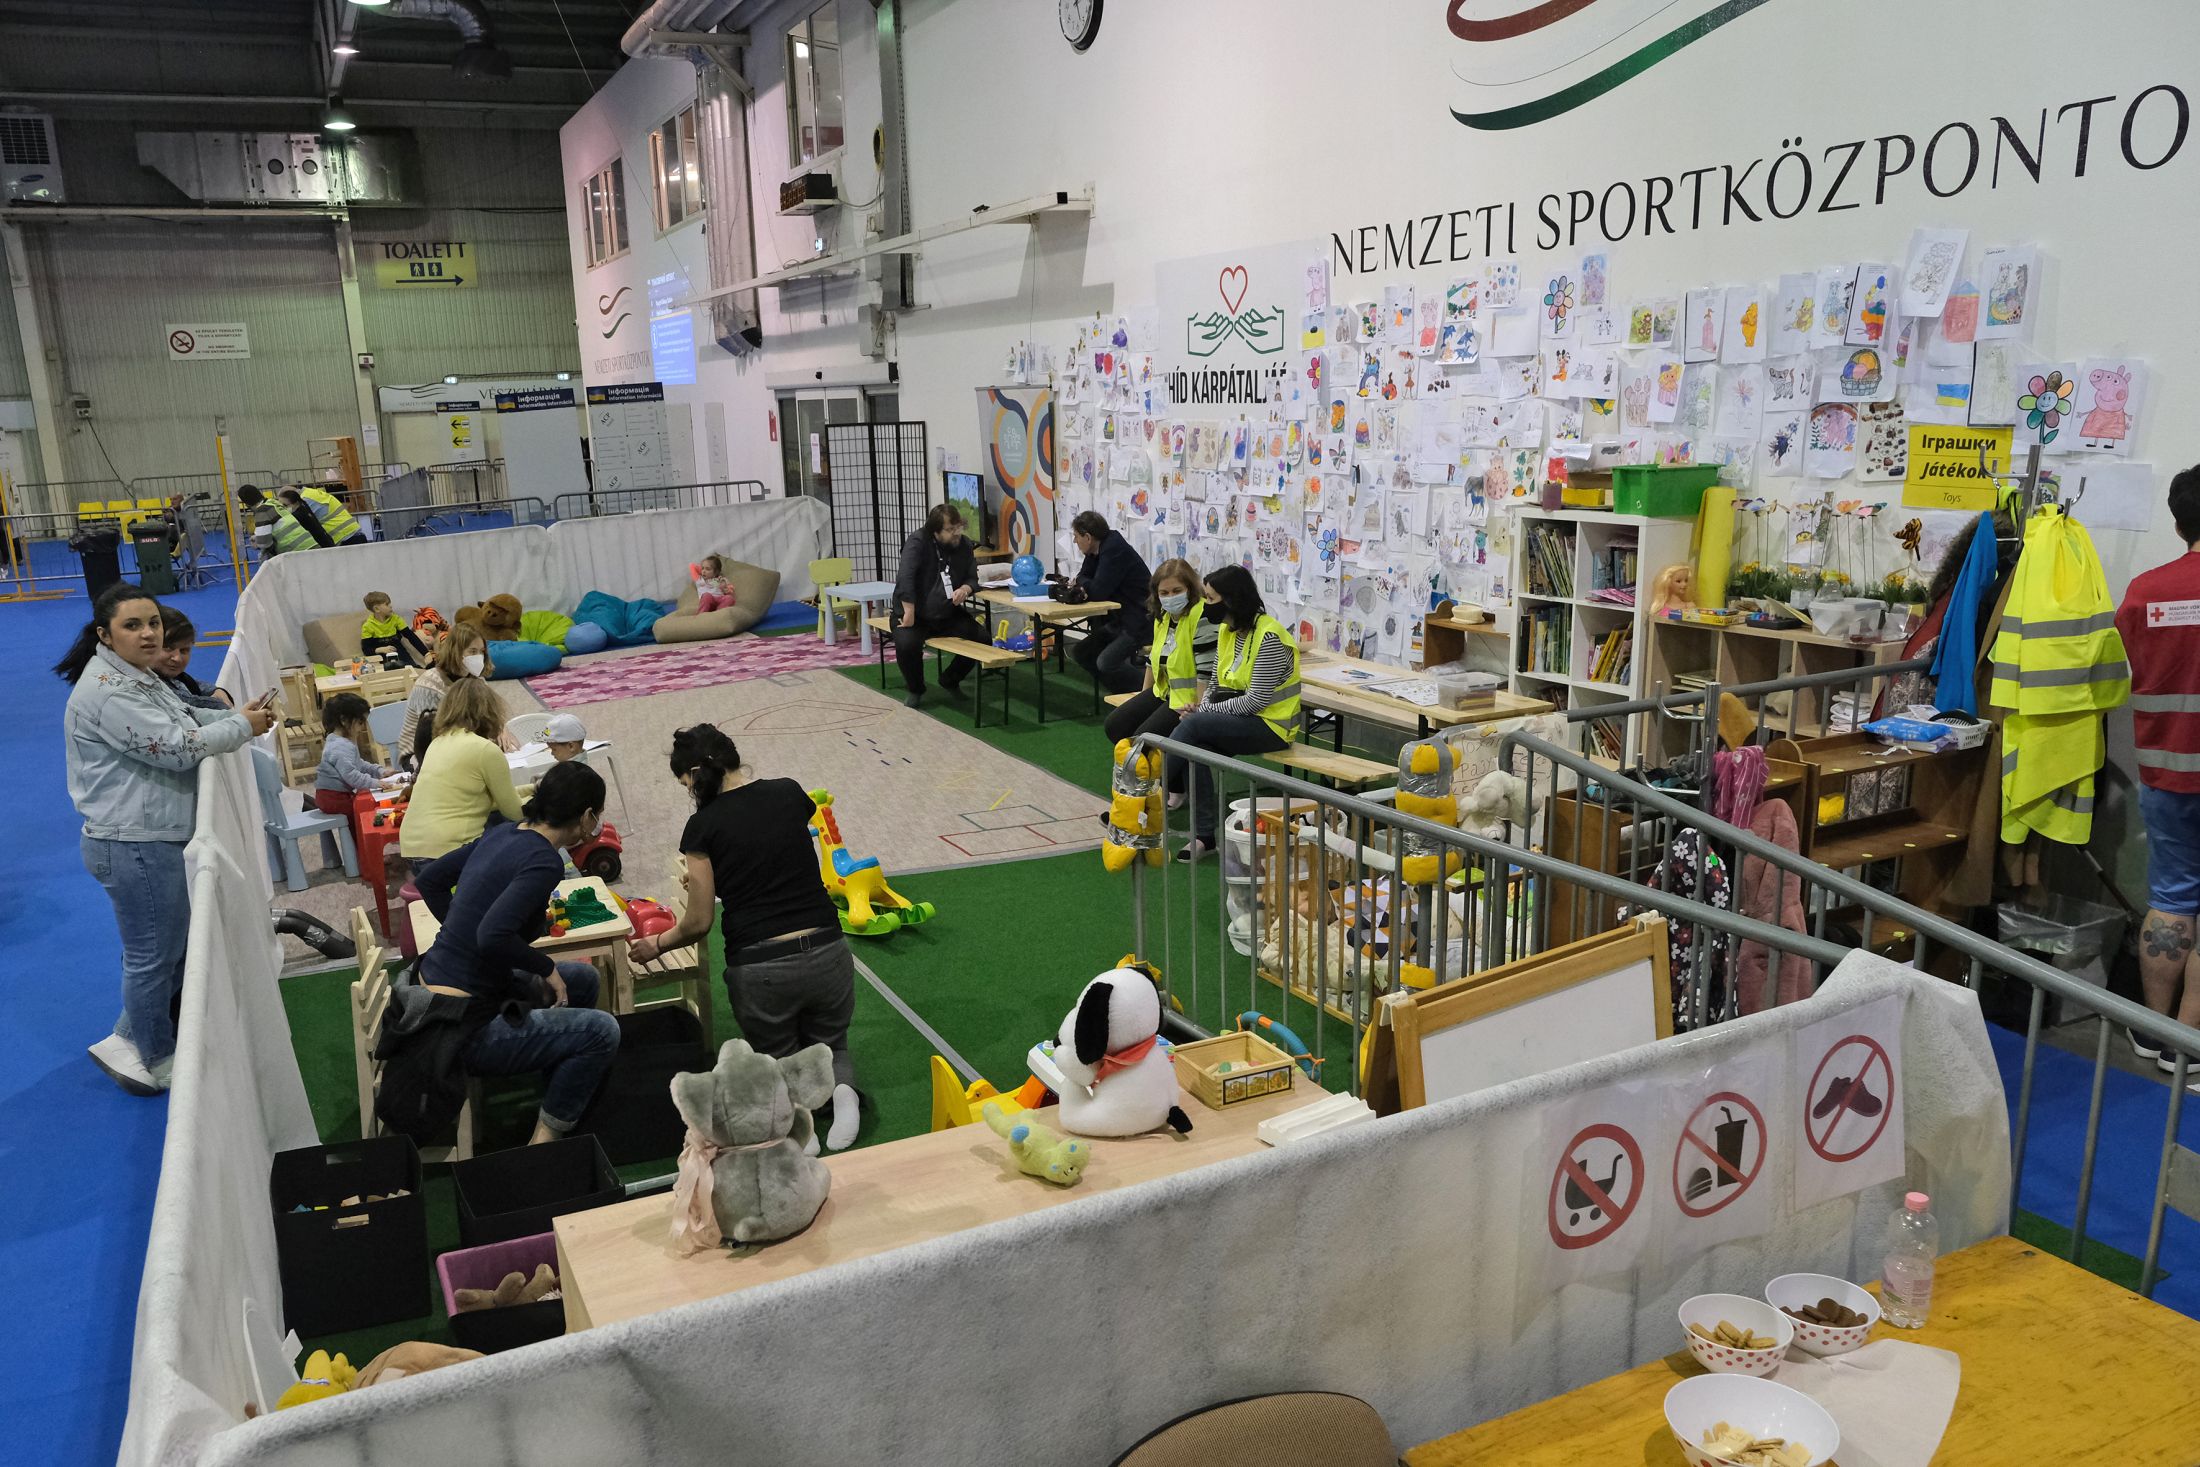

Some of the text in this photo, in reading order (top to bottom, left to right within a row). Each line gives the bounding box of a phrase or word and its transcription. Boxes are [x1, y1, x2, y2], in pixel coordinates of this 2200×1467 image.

[1331, 84, 2190, 276] NEMZETI SPORTKÖZPONTO
[380, 241, 467, 259] TOALETT
[607, 386, 650, 396] Інформація
[1168, 362, 1287, 404] HÍD KÁRPÁTAL
[517, 392, 560, 403] Інформація
[1922, 434, 1997, 453] Іграшки
[1943, 492, 1962, 505] Toys
